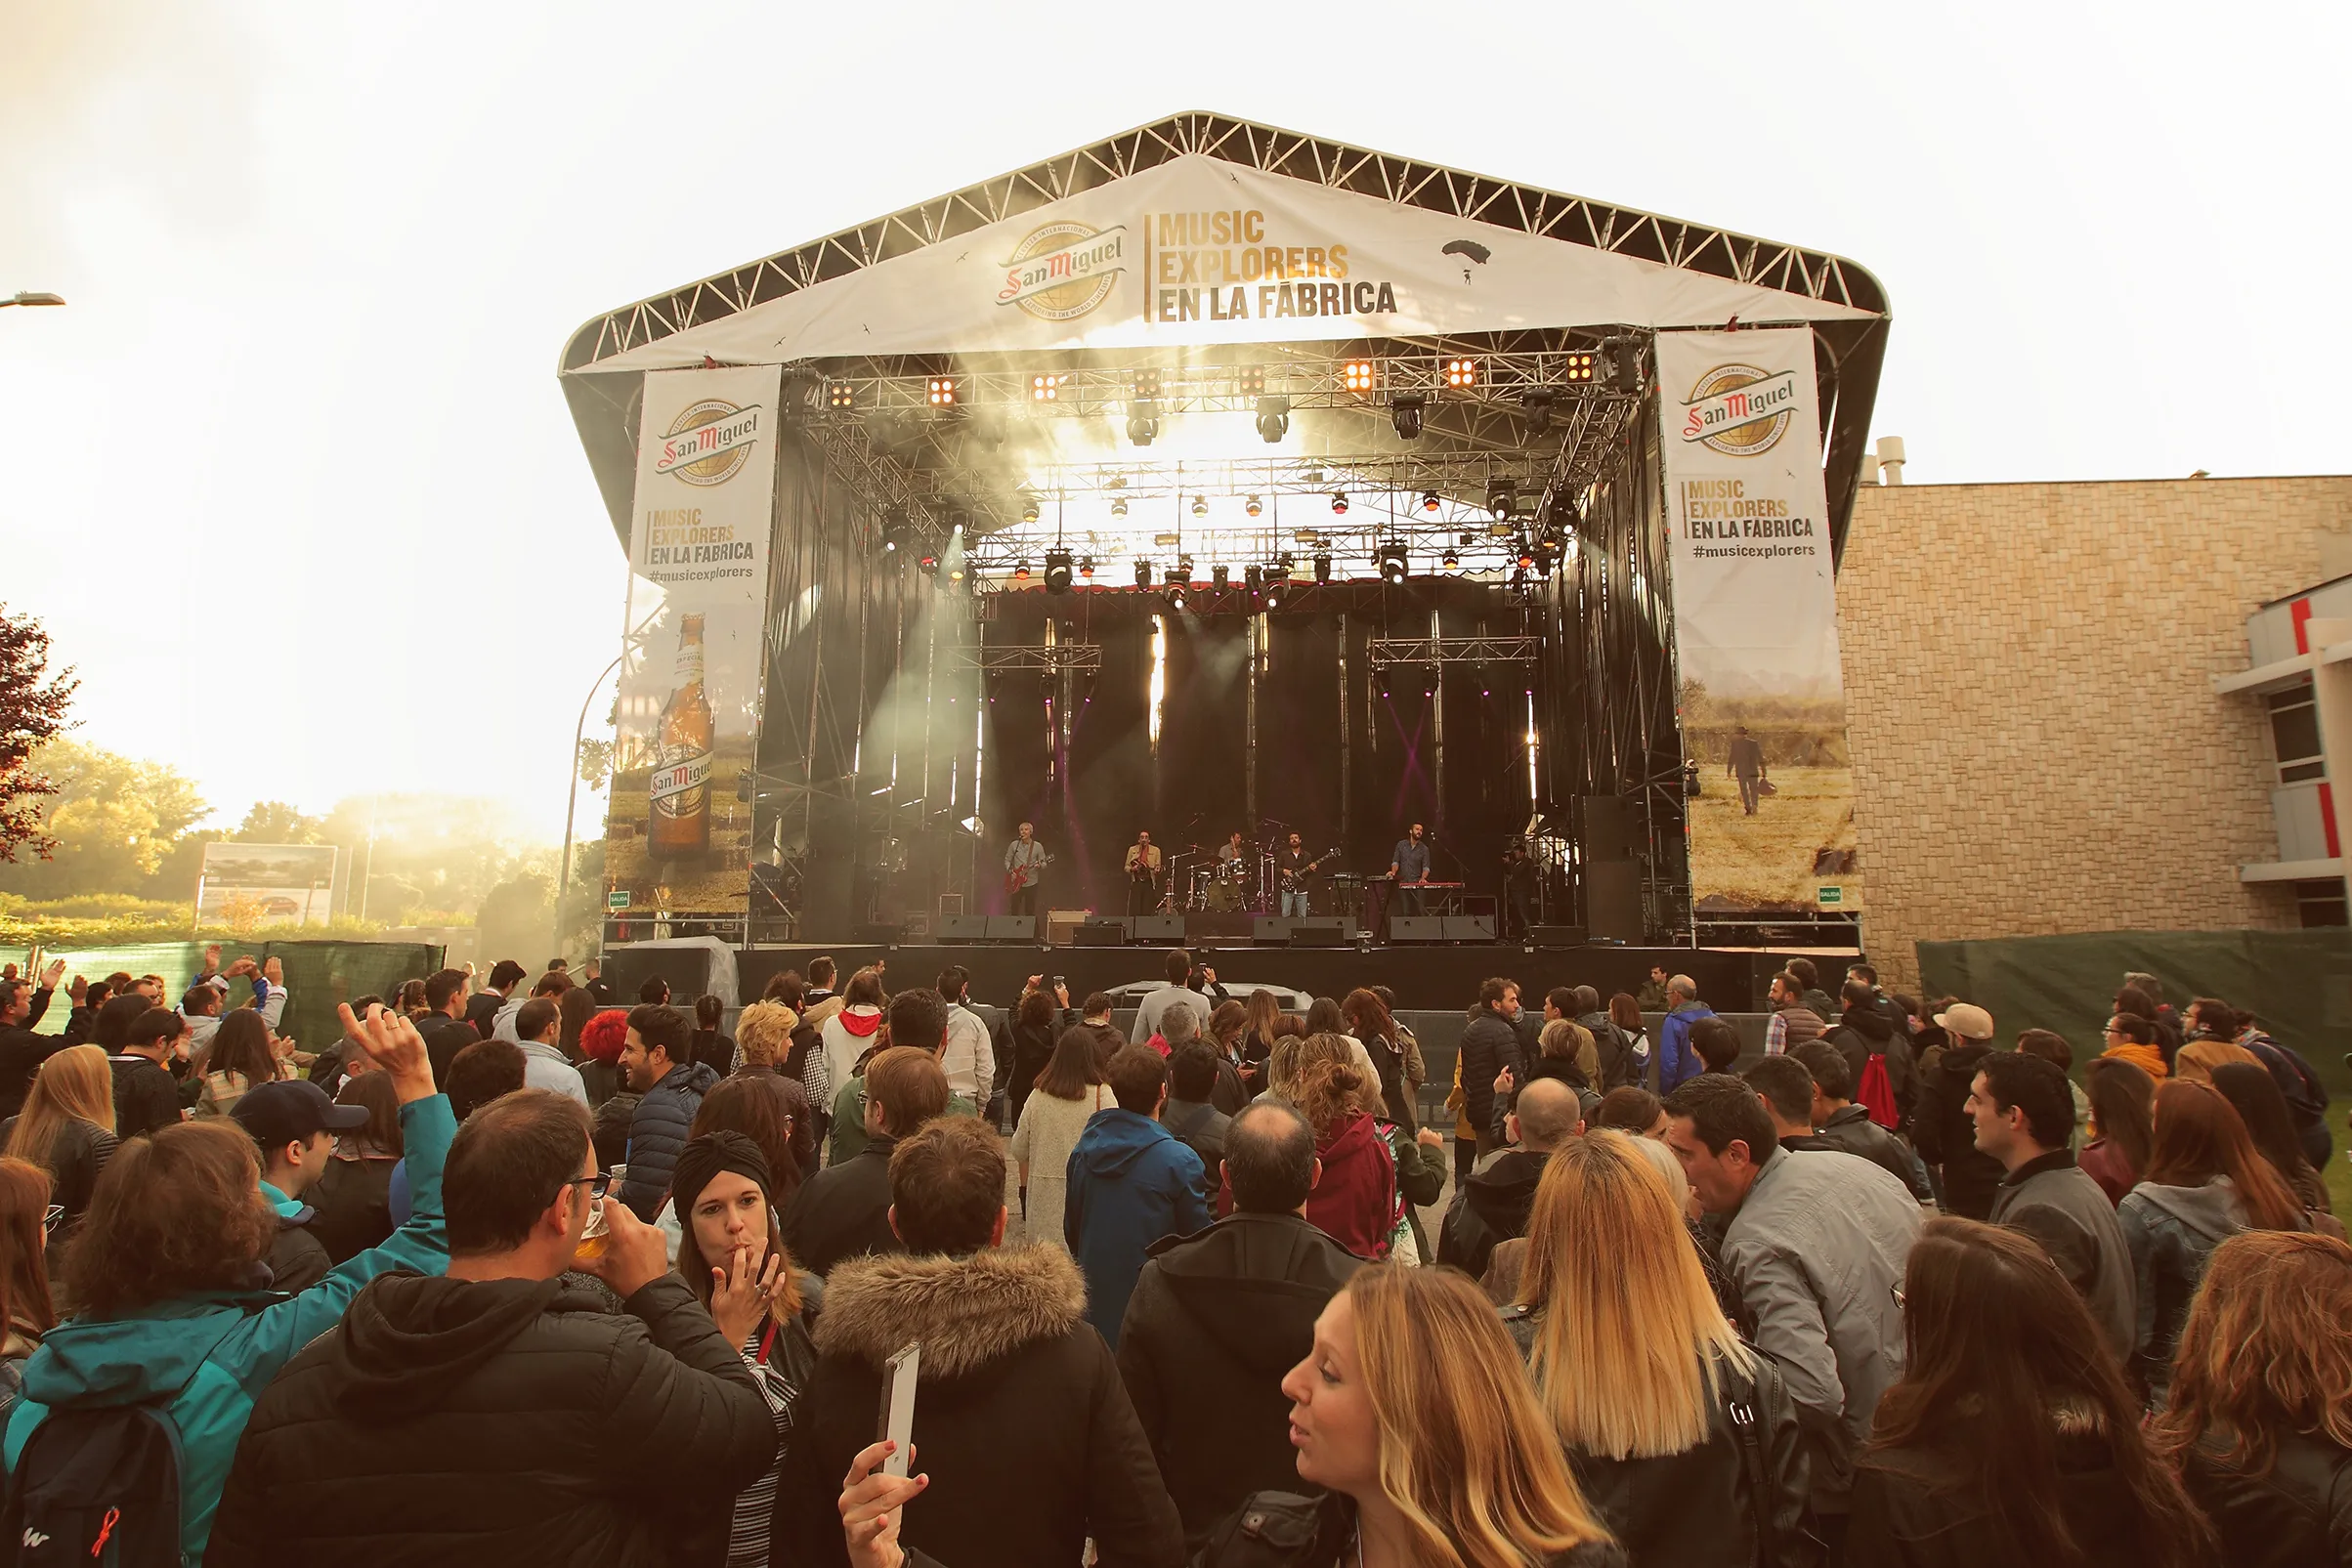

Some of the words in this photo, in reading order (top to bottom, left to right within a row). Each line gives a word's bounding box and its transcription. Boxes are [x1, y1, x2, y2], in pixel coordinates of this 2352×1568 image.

[1159, 210, 1264, 246] MUSIC
[1159, 244, 1349, 284] EXPLORERS
[1159, 287, 1200, 322] EN
[1210, 286, 1250, 320] LA
[1689, 480, 1744, 498] MUSIC
[653, 508, 702, 527] MUSIC
[1689, 498, 1789, 519] EXPLORERS
[652, 524, 735, 546] EXPLORERS
[1691, 521, 1714, 539] EN
[1718, 520, 1739, 538] LA
[650, 547, 670, 565] EN
[673, 546, 691, 564] LA
[1692, 544, 1816, 559] #musicexplorers
[649, 567, 753, 582] #musicexplorers
